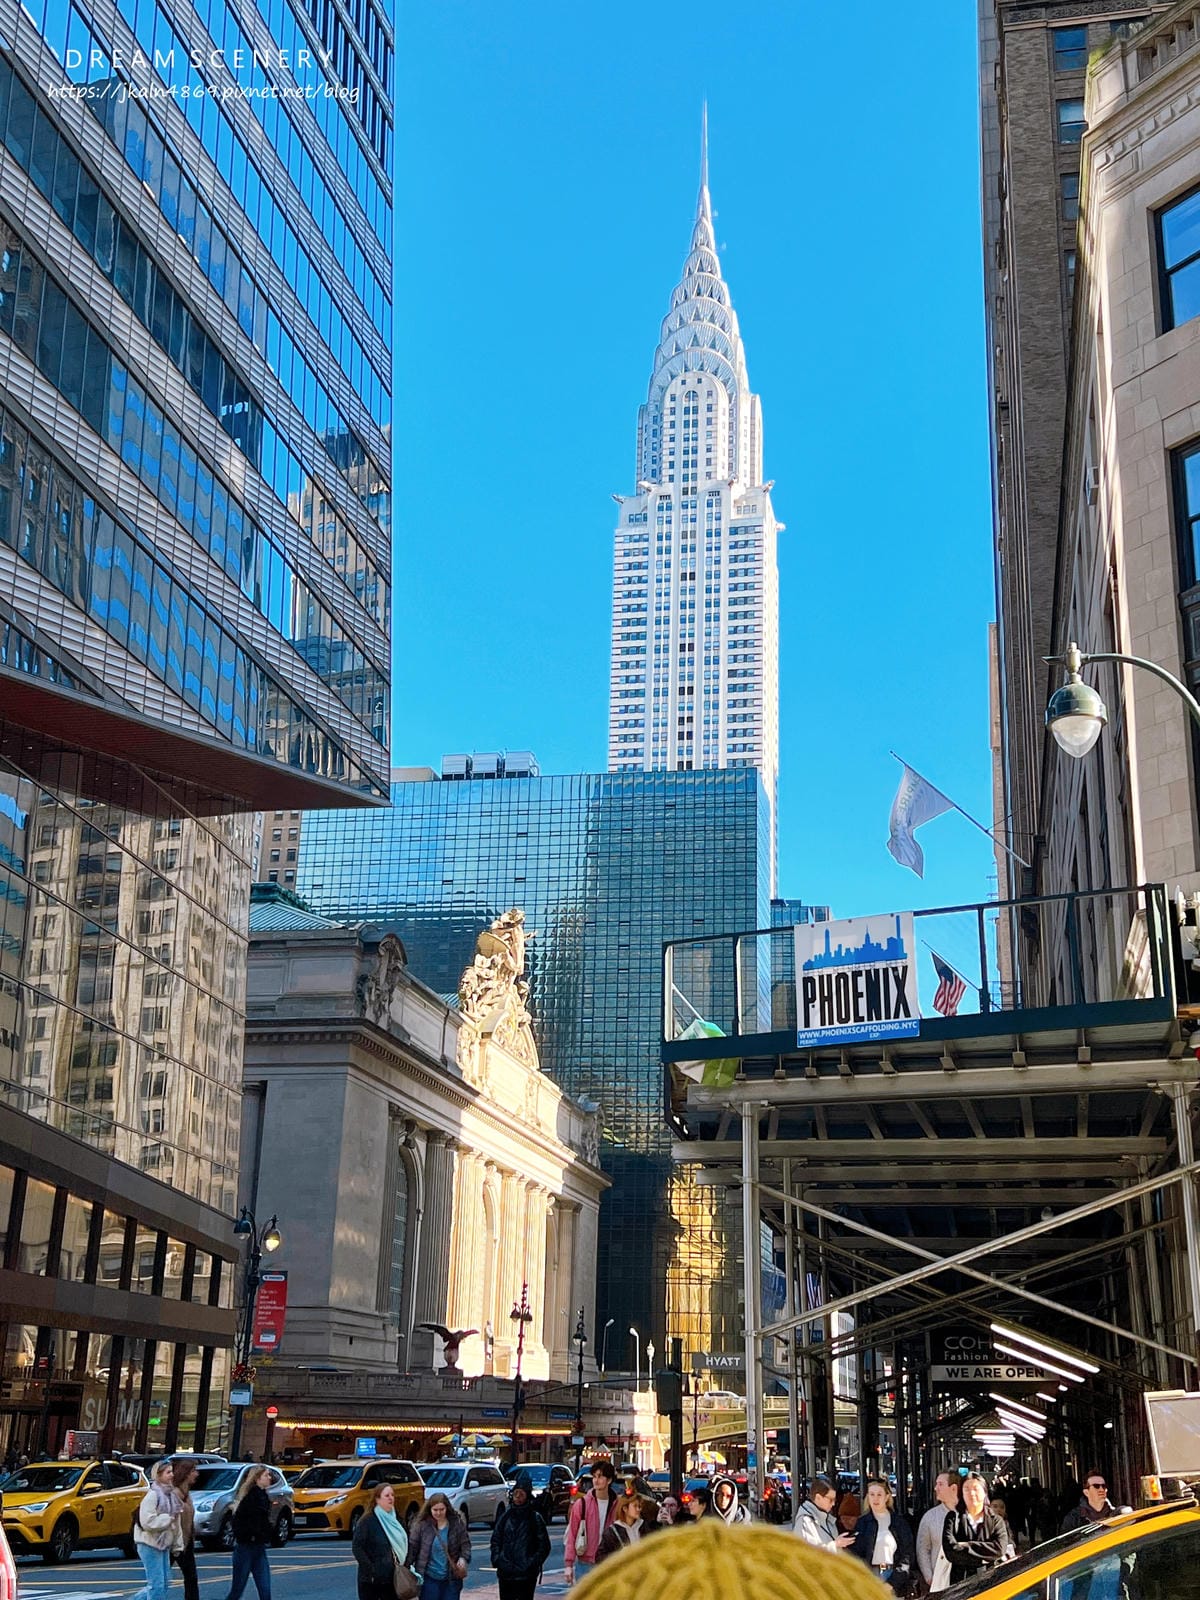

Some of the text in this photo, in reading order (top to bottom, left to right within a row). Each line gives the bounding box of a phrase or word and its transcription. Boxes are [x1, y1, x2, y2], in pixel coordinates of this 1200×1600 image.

[802, 965, 911, 1029] PHOENIX
[799, 1021, 918, 1039] WWW.PHOENIXSCAFFOLDING.NYC
[944, 1350, 989, 1361] Fashion
[705, 1356, 741, 1367] HYATT
[945, 1367, 1045, 1378] WE ARE OPEN
